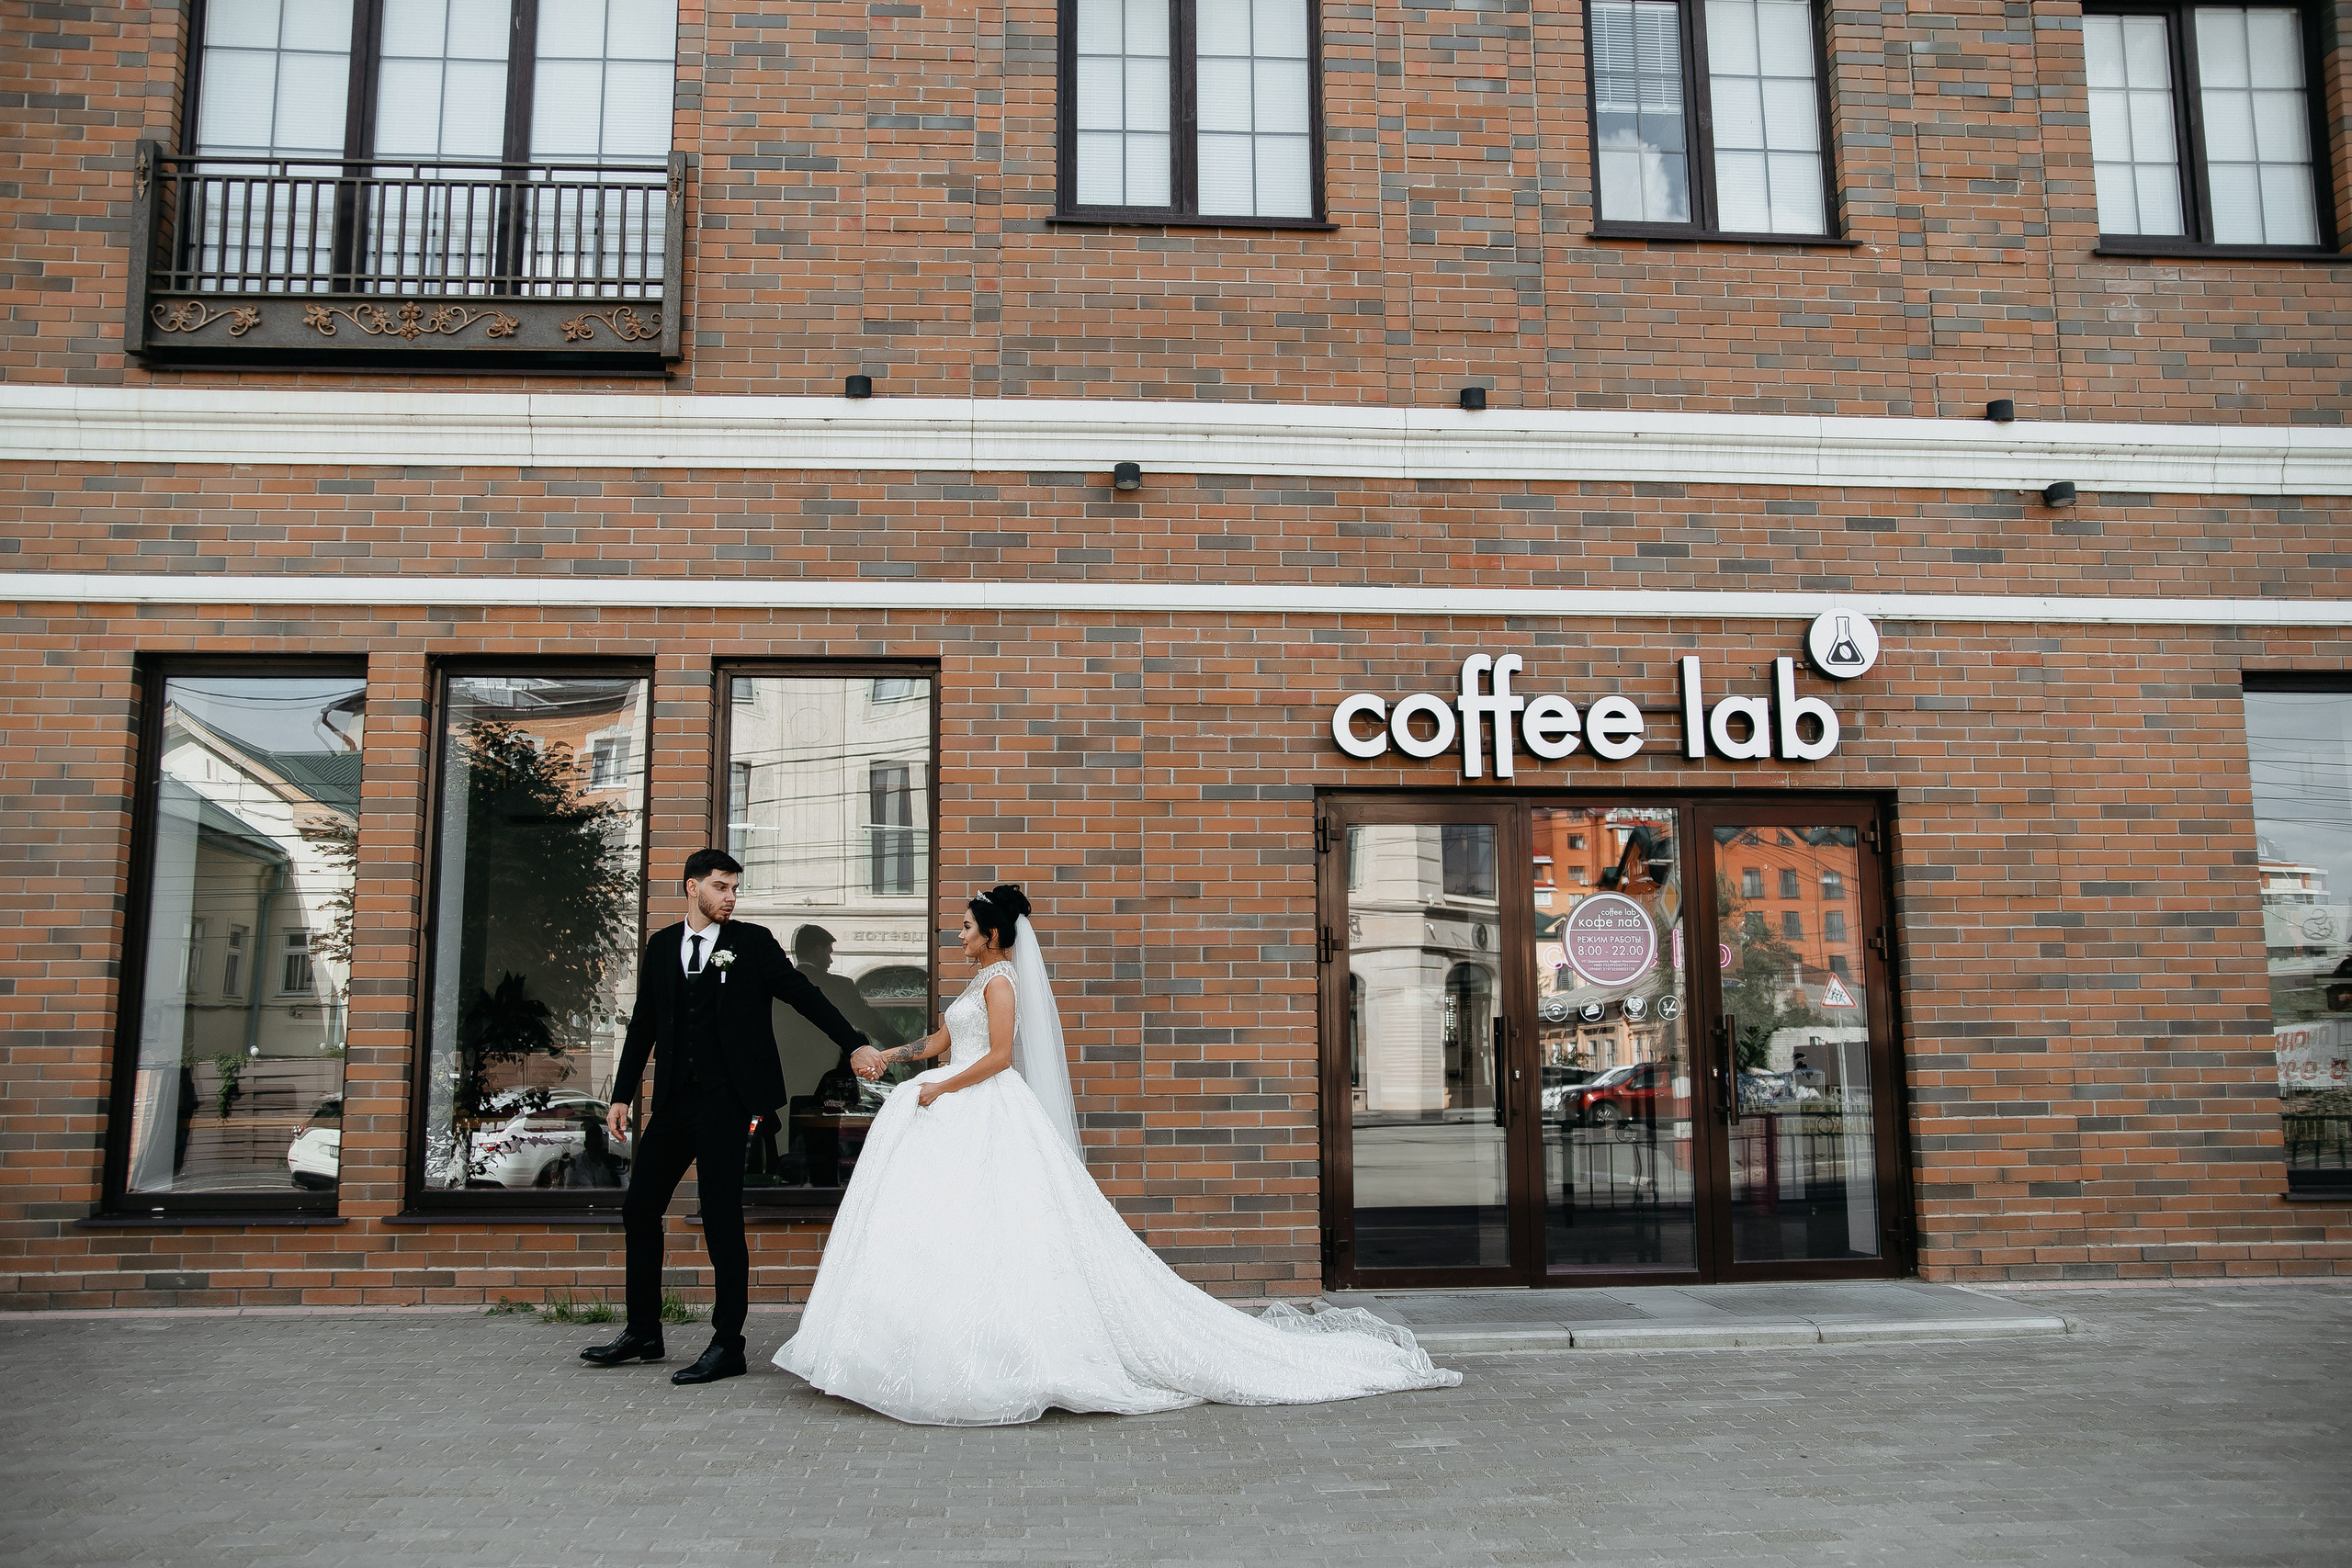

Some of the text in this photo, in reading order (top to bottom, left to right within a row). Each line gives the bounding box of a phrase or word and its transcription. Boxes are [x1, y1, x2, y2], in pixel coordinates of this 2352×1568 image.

[1331, 653, 1840, 779] coffee lab
[1600, 908, 1636, 917] coffee lab
[1578, 914, 1641, 930] кофе лаб
[1577, 945, 1602, 956] 8.00
[1611, 945, 1644, 956] 22.00
